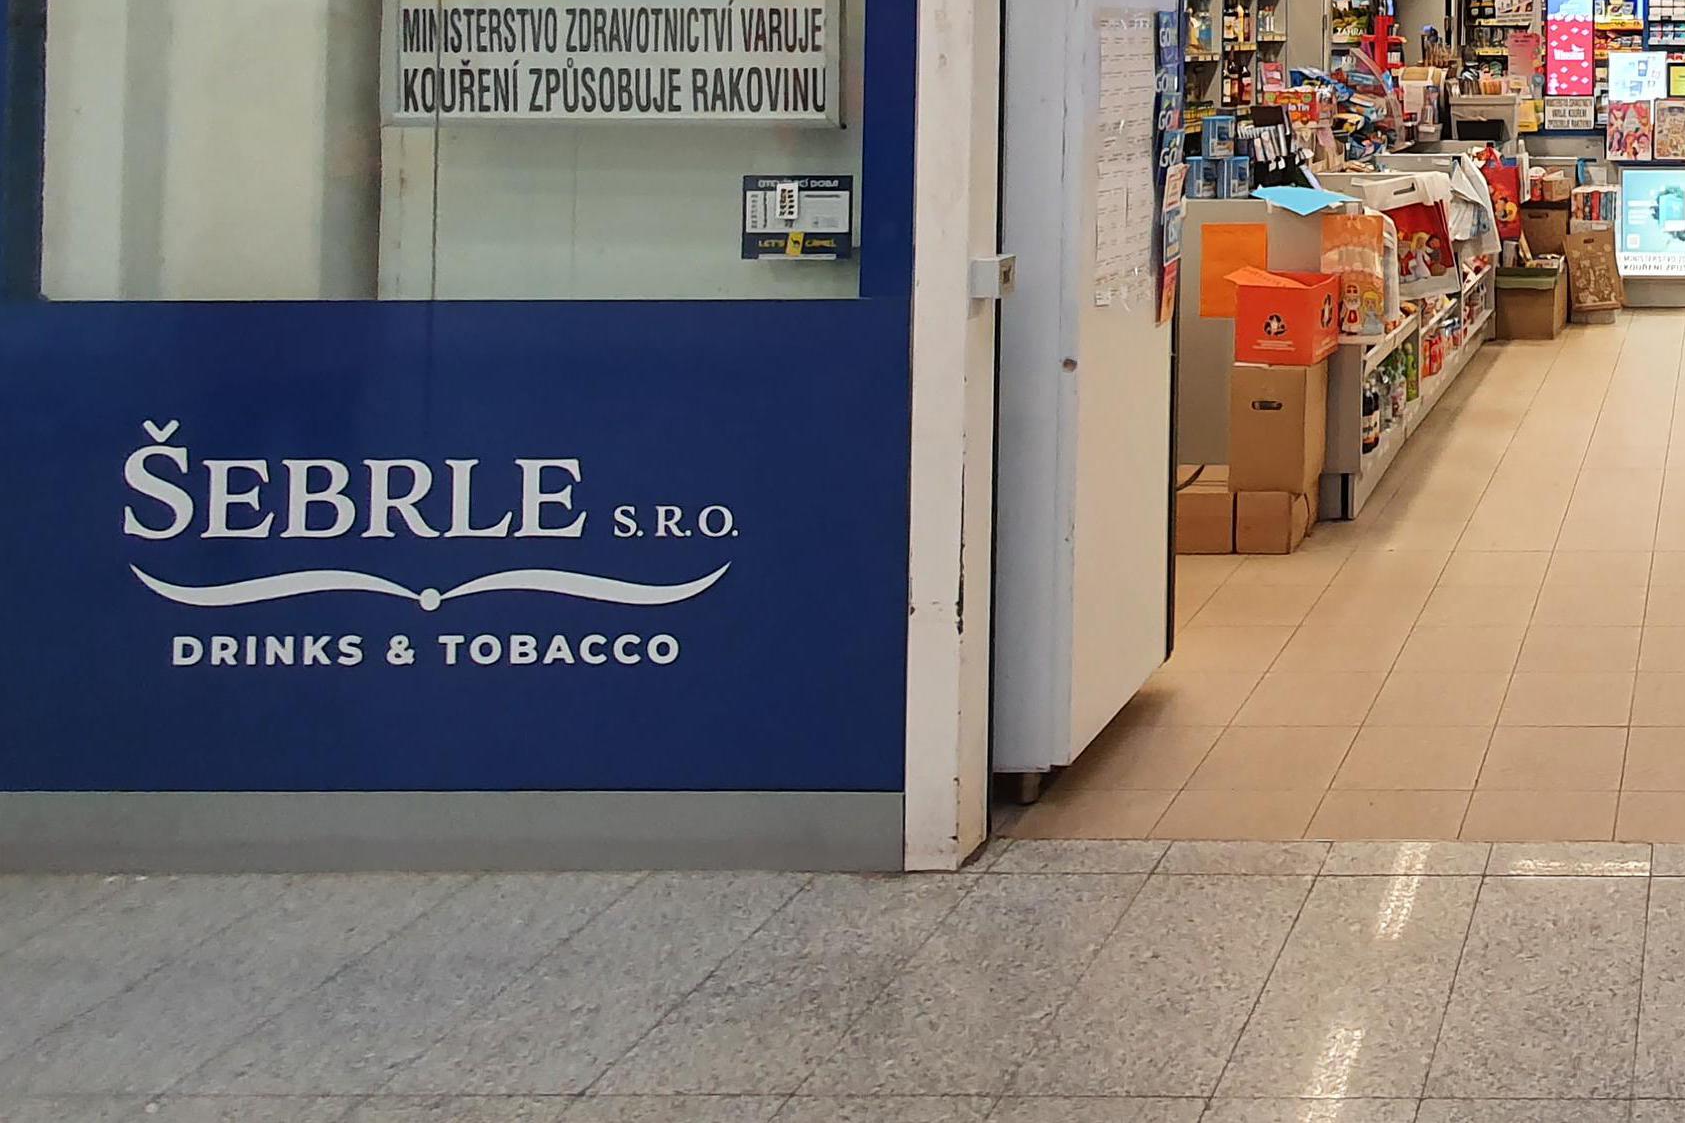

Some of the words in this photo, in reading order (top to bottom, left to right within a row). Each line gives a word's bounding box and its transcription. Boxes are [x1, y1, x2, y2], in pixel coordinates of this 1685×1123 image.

[402, 7, 557, 55] MINISTERSTVO
[565, 0, 734, 55] ZDRAVOTNICTVÍ
[403, 60, 521, 114] KOUŘENÍ
[528, 57, 682, 114] ZPŮSOBUJE
[692, 66, 826, 114] RAKOVINU
[124, 419, 587, 540] ŠEBRLE
[613, 505, 739, 538] S.R.O.
[172, 635, 363, 666] DRINKS
[386, 635, 416, 665] &
[437, 634, 680, 665] TOBACCO
